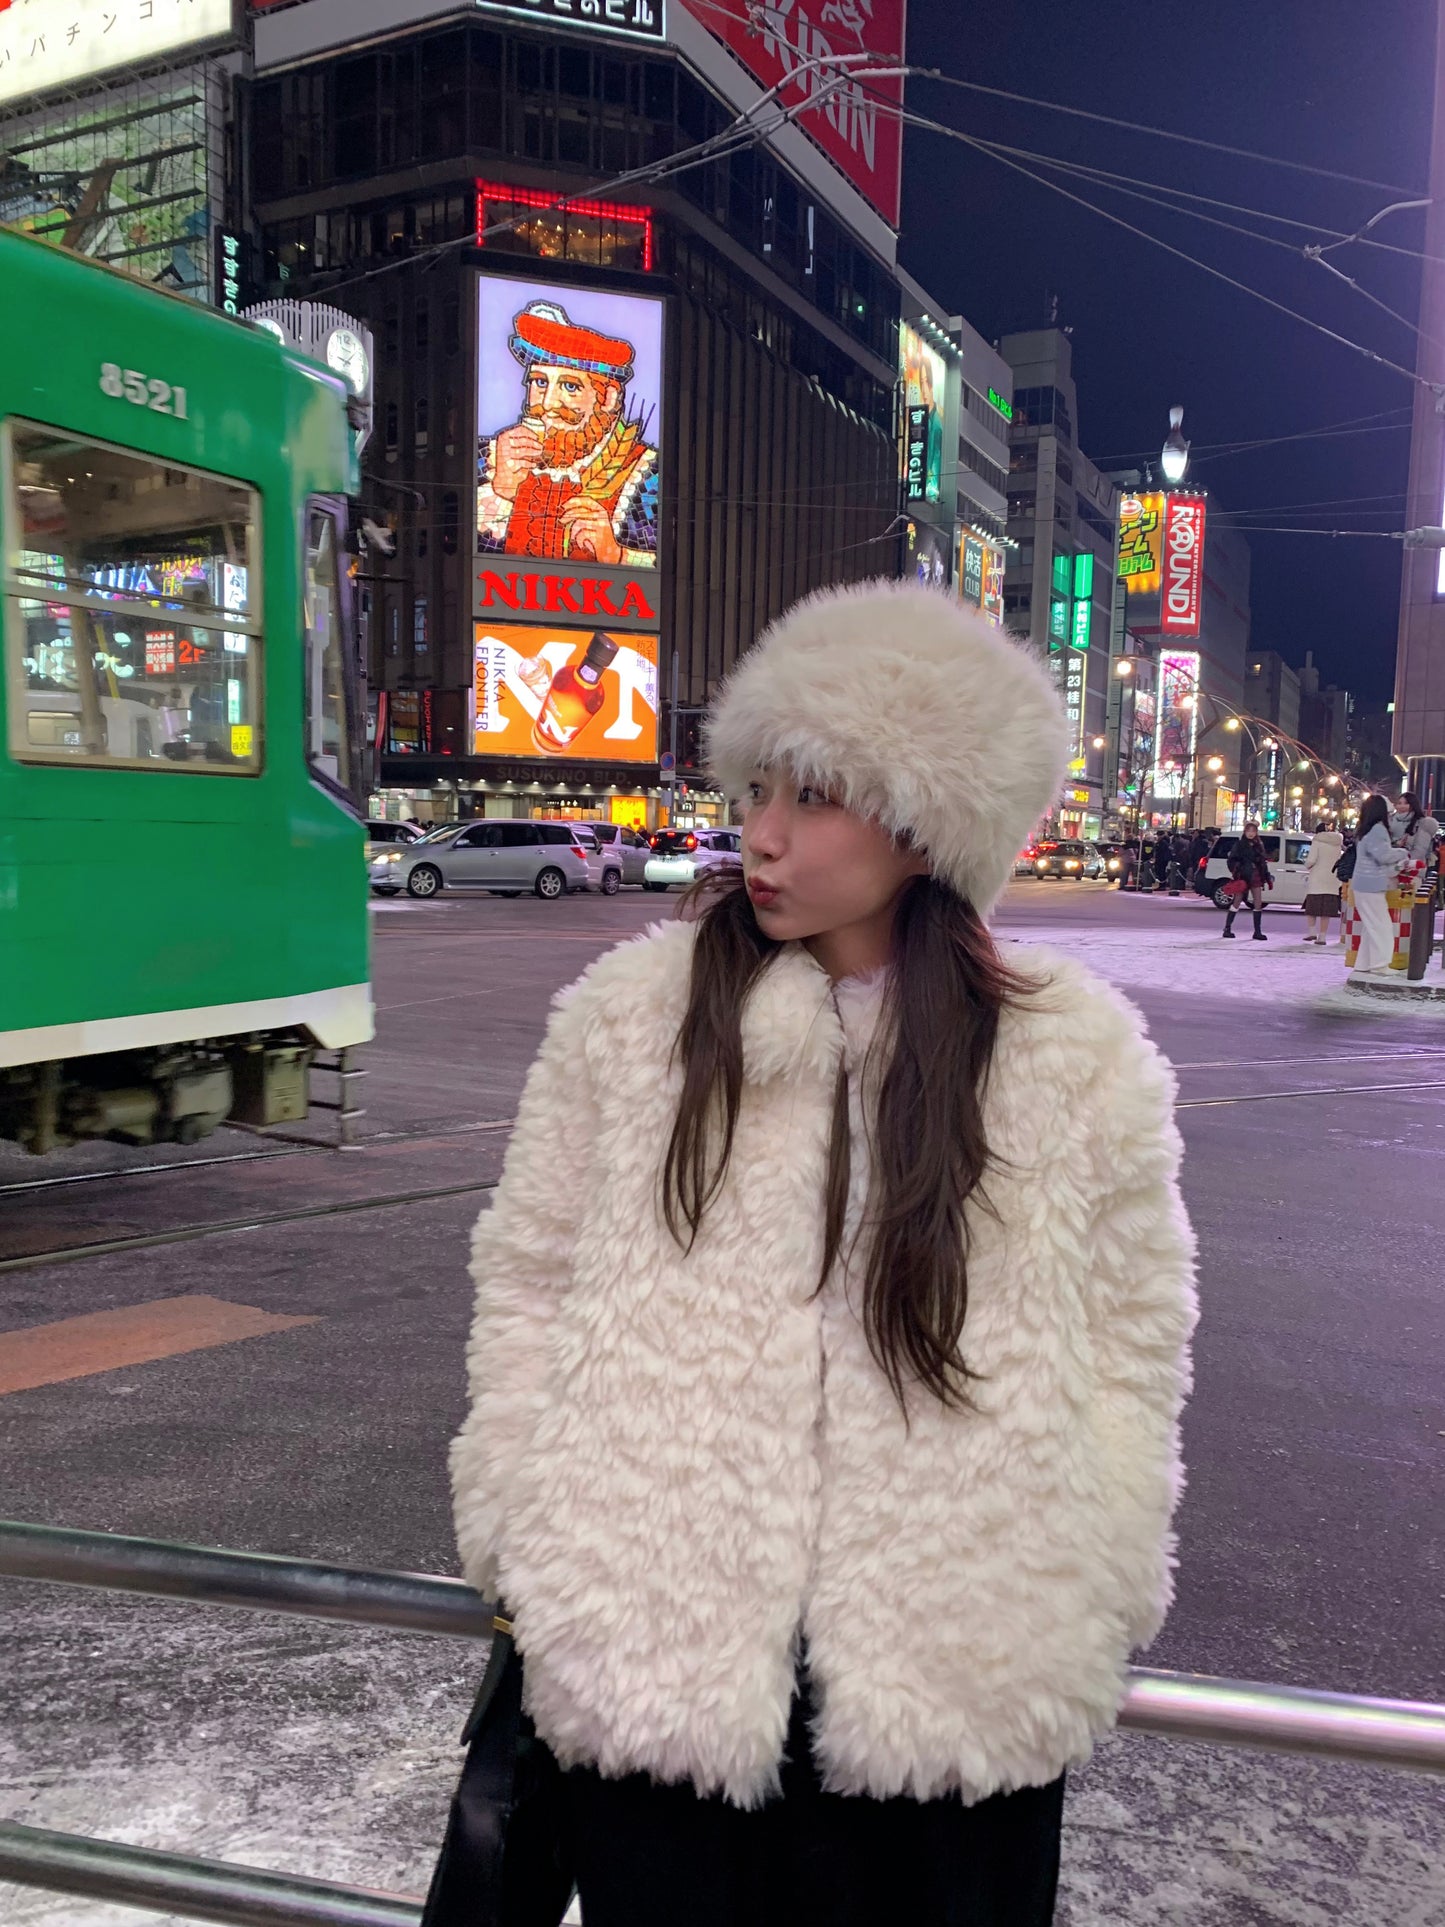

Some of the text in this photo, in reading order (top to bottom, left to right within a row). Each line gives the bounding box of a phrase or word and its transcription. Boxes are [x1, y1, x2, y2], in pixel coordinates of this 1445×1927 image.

[99, 361, 190, 421] 8521
[477, 569, 656, 619] NIKKA
[1167, 505, 1196, 624] ROUND1
[1190, 543, 1199, 611] ENTERTAINMENT
[475, 646, 489, 731] FRONTIER
[494, 647, 506, 703] NIKKA
[496, 766, 587, 784] SUSUKINO
